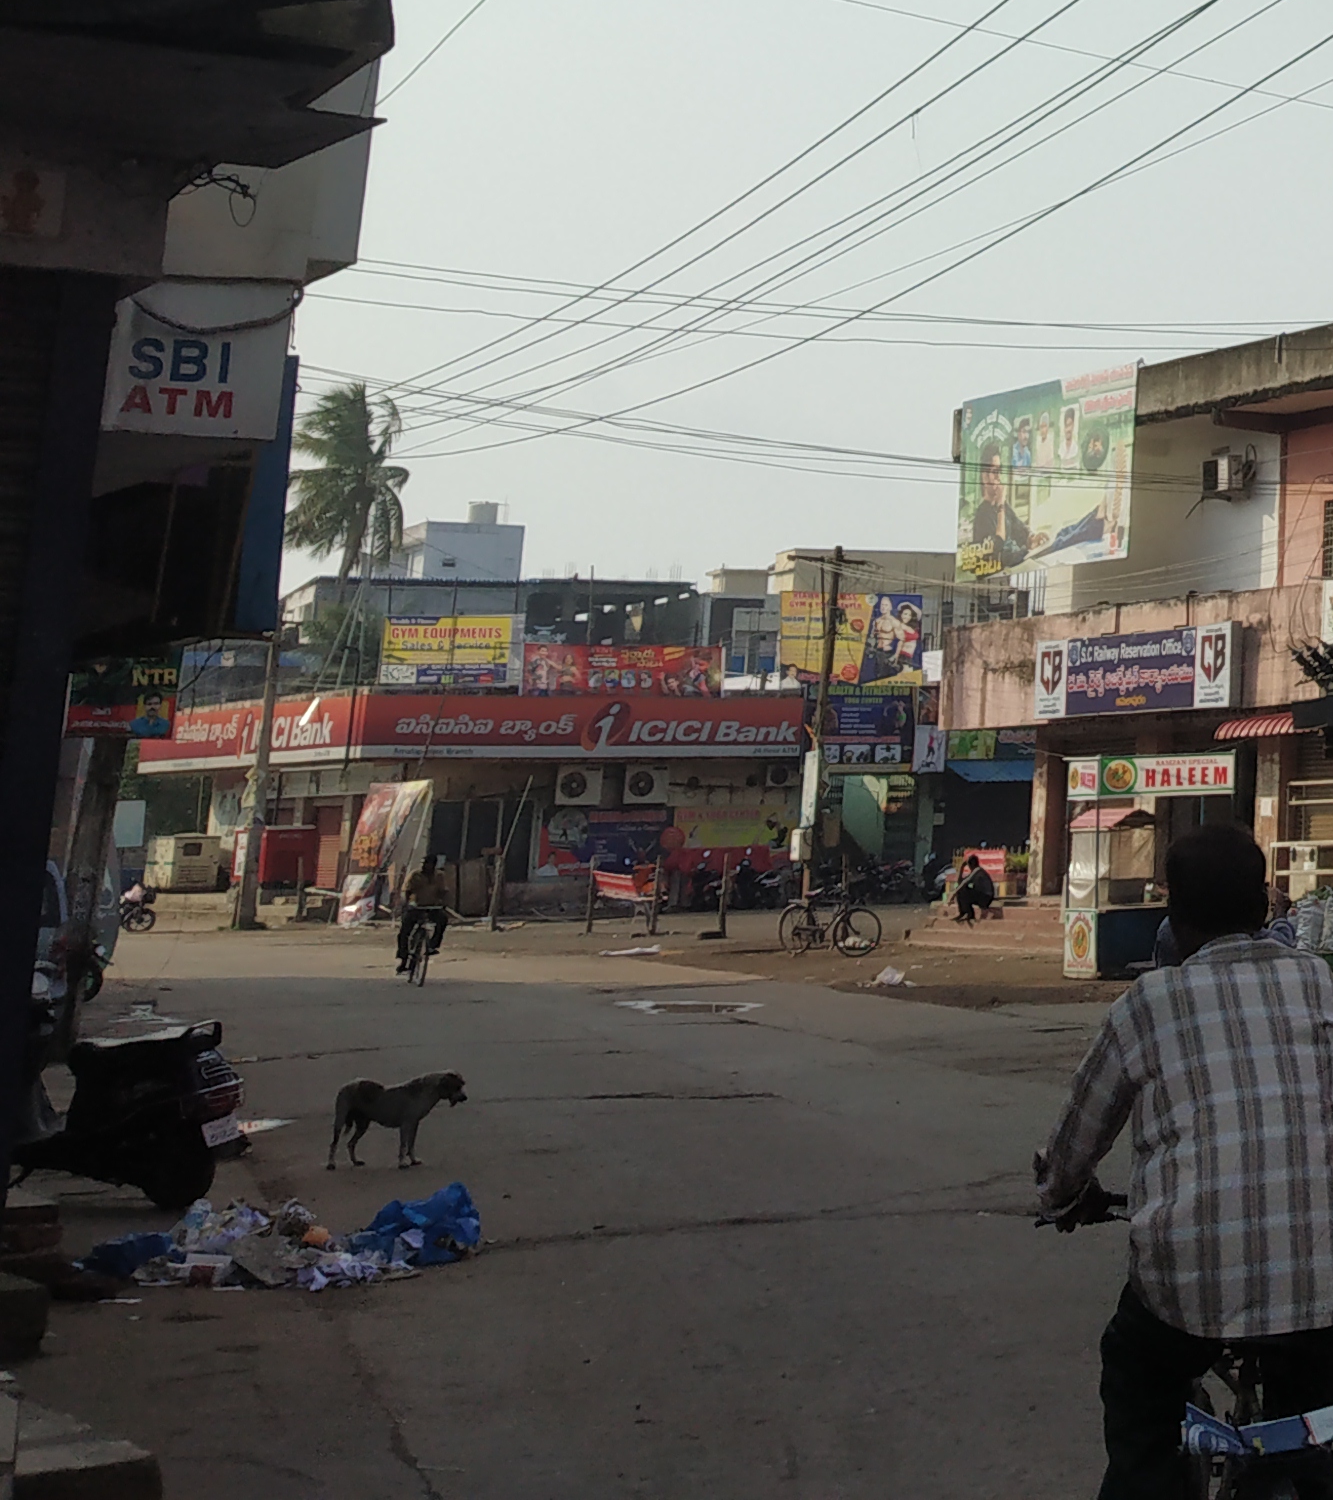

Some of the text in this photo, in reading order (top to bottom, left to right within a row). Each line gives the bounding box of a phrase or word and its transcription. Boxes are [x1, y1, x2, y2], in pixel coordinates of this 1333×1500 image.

[128, 338, 232, 384] SBI
[120, 385, 234, 419] ATM
[391, 627, 503, 639] GYM EQUIPMENTS
[401, 640, 432, 650] Sales
[449, 640, 491, 650] Service
[1094, 644, 1119, 664] Railway
[1120, 640, 1160, 659] Reservation
[1161, 638, 1182, 656] Office
[132, 664, 177, 687] NTR
[289, 712, 334, 747] Bank
[395, 713, 578, 742] ఐసిఐసిఐ బ్యాంక్
[628, 720, 798, 743] ICICI Bank
[1155, 758, 1219, 767] RAMZAN SPECIAL
[1145, 765, 1228, 788] HALEEM
